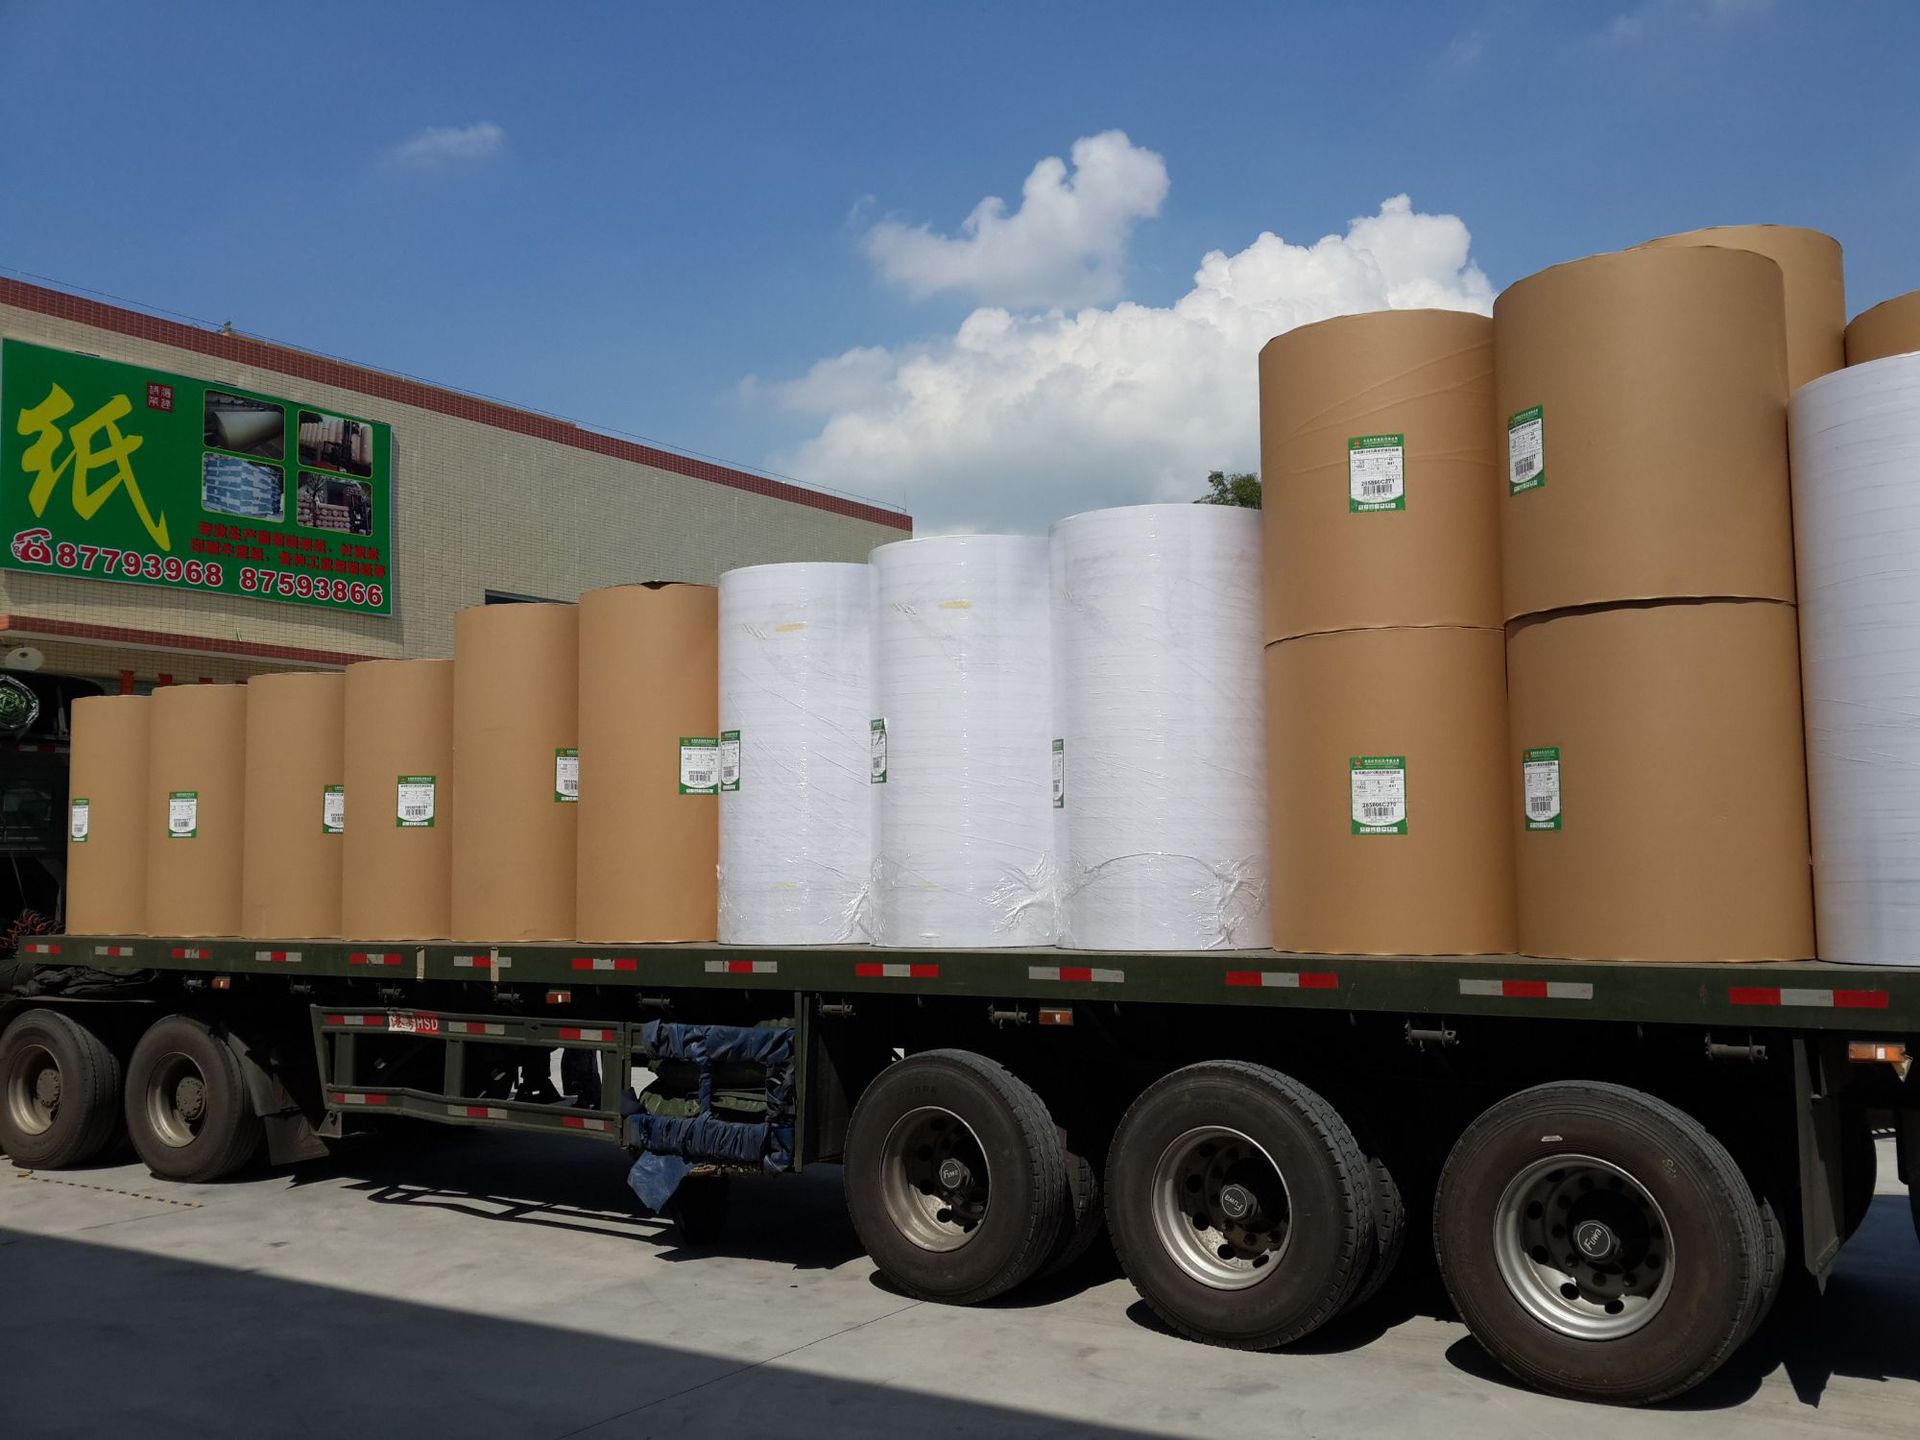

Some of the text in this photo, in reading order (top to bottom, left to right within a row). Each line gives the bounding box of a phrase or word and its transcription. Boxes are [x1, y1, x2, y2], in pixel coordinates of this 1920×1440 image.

[17, 382, 171, 551] 纸
[56, 542, 384, 607] 87793968 87593866
